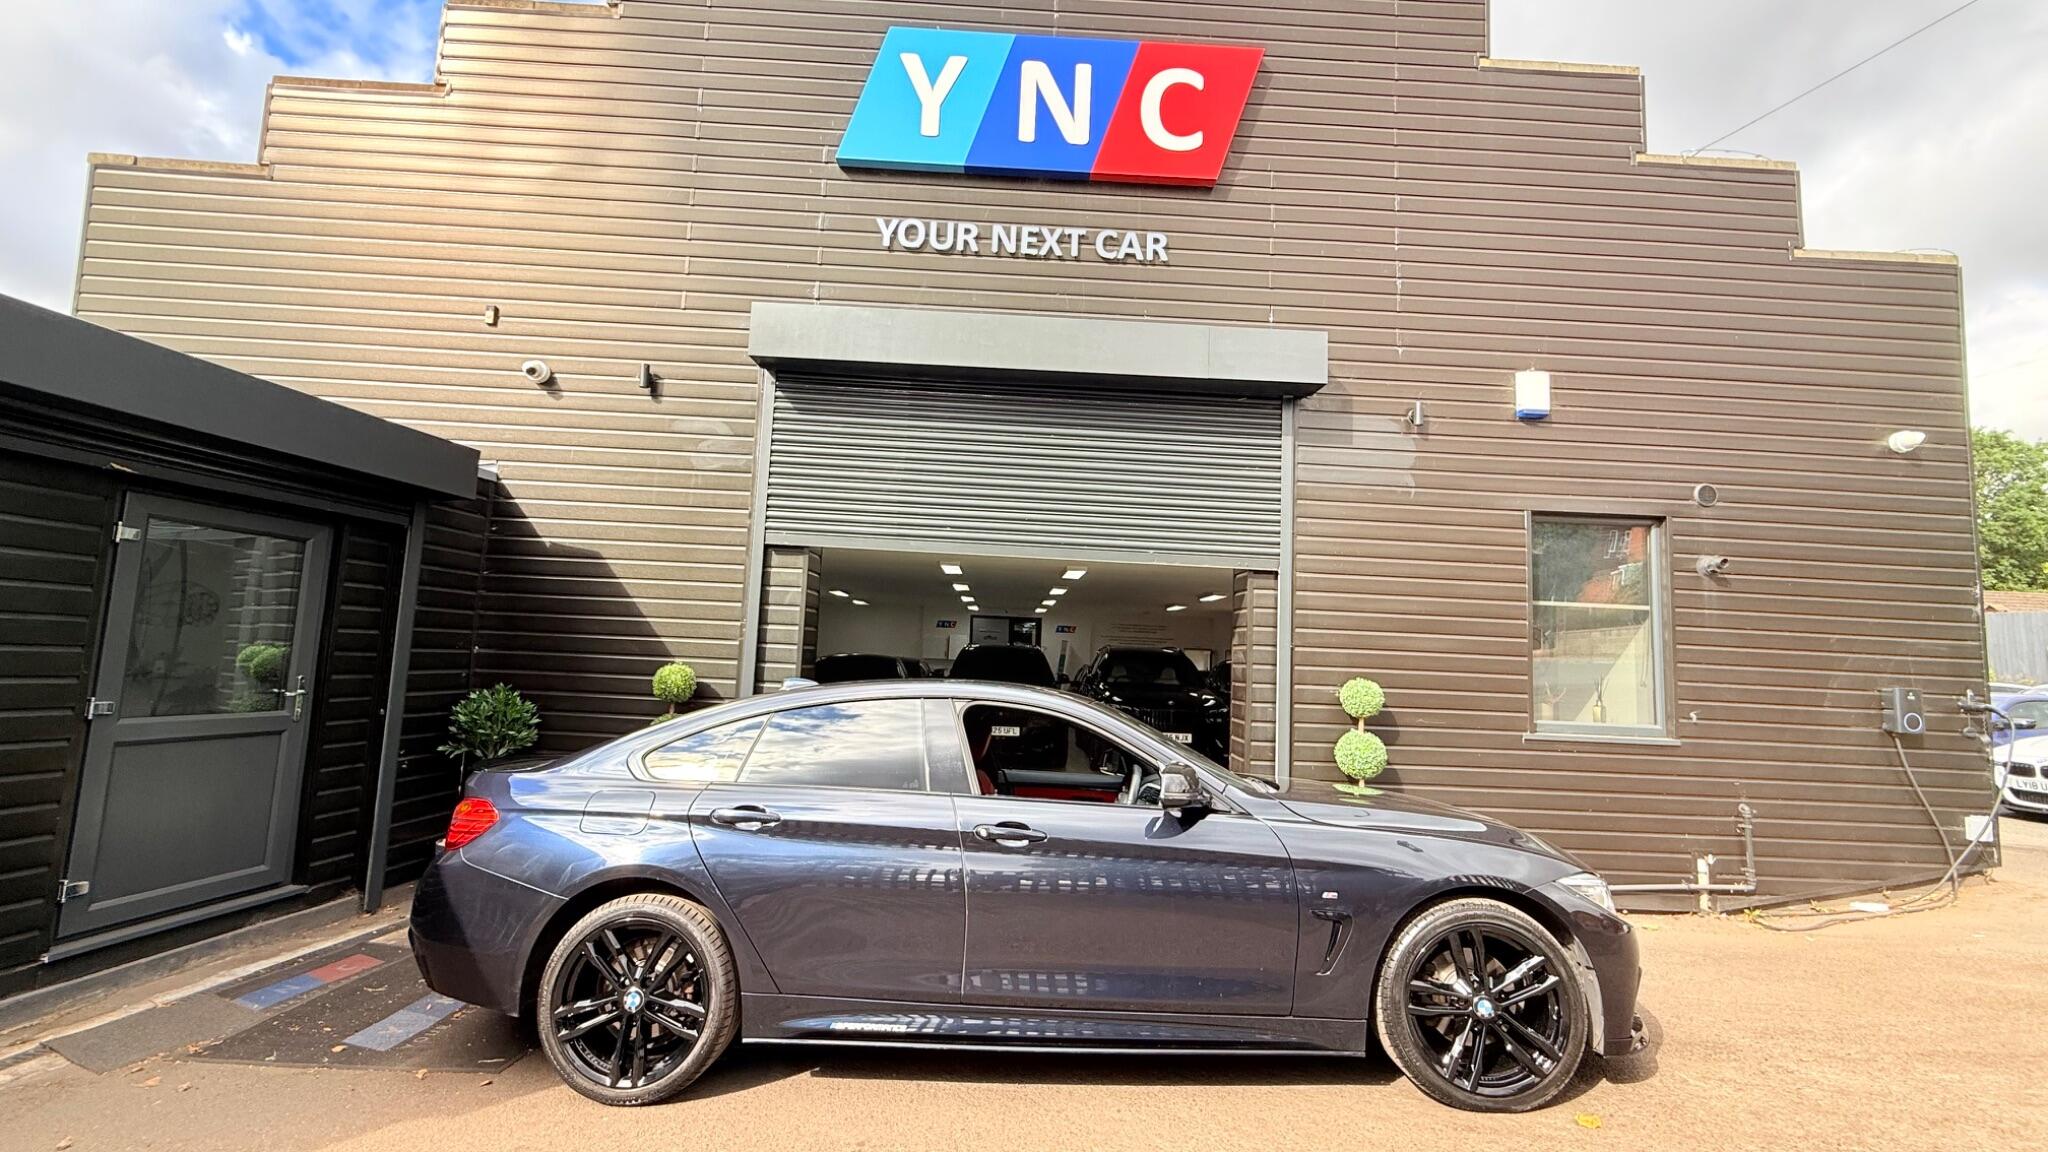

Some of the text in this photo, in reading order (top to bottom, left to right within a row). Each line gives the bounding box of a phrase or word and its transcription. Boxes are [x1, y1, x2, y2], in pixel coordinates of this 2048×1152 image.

[900, 52, 1205, 152] YNC
[875, 216, 1169, 262] YOUR NEXT CAR
